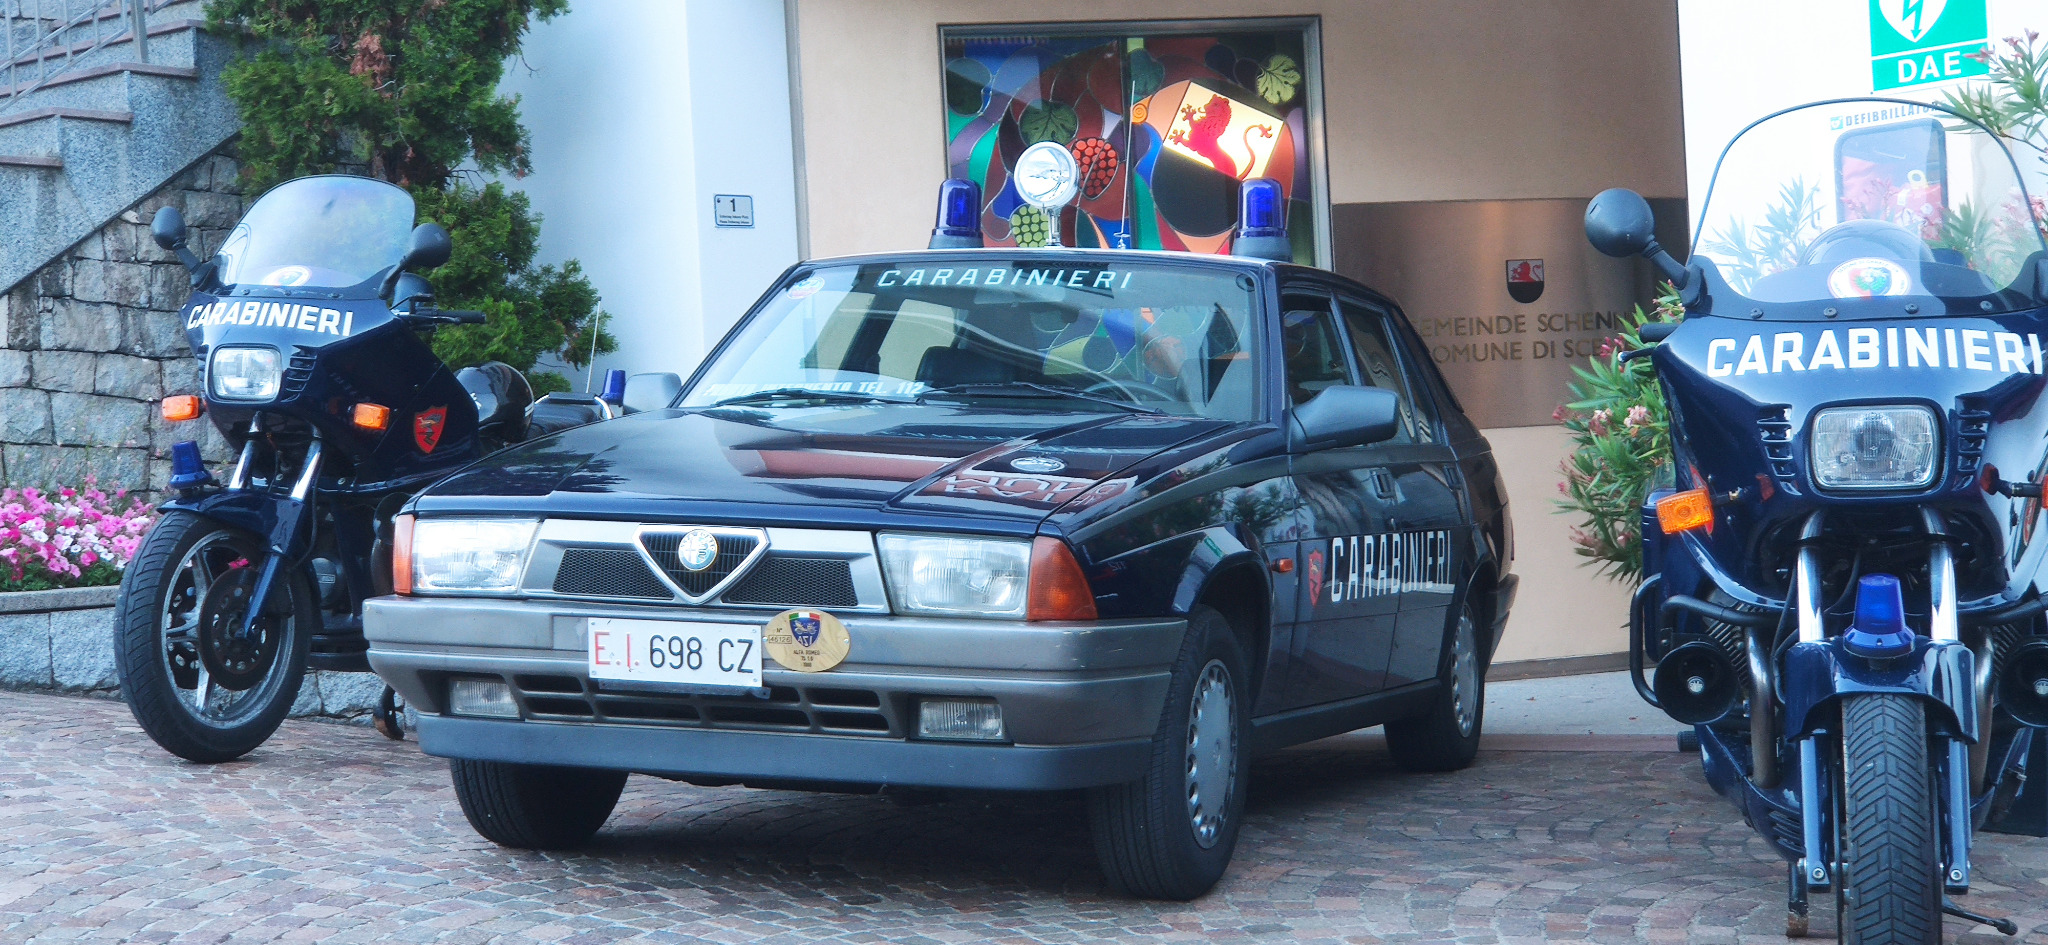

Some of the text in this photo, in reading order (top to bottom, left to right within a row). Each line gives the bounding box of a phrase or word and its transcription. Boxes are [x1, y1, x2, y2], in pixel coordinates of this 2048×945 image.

[1898, 51, 1961, 83] DAE
[1845, 102, 1937, 126] DEFIBRILLATO
[730, 198, 736, 212] 1
[877, 268, 1132, 289] CARABINIERI
[187, 301, 353, 337] CARABINIERI
[1537, 310, 1632, 333] SCHENN
[1433, 340, 1523, 364] OMUNE
[1533, 339, 1556, 360] DI
[1707, 327, 2043, 378] CARABINIERI
[897, 381, 924, 394] 112
[1331, 530, 1450, 602] CARABINIERI
[650, 635, 703, 671] 698
[718, 638, 754, 674] CZ
